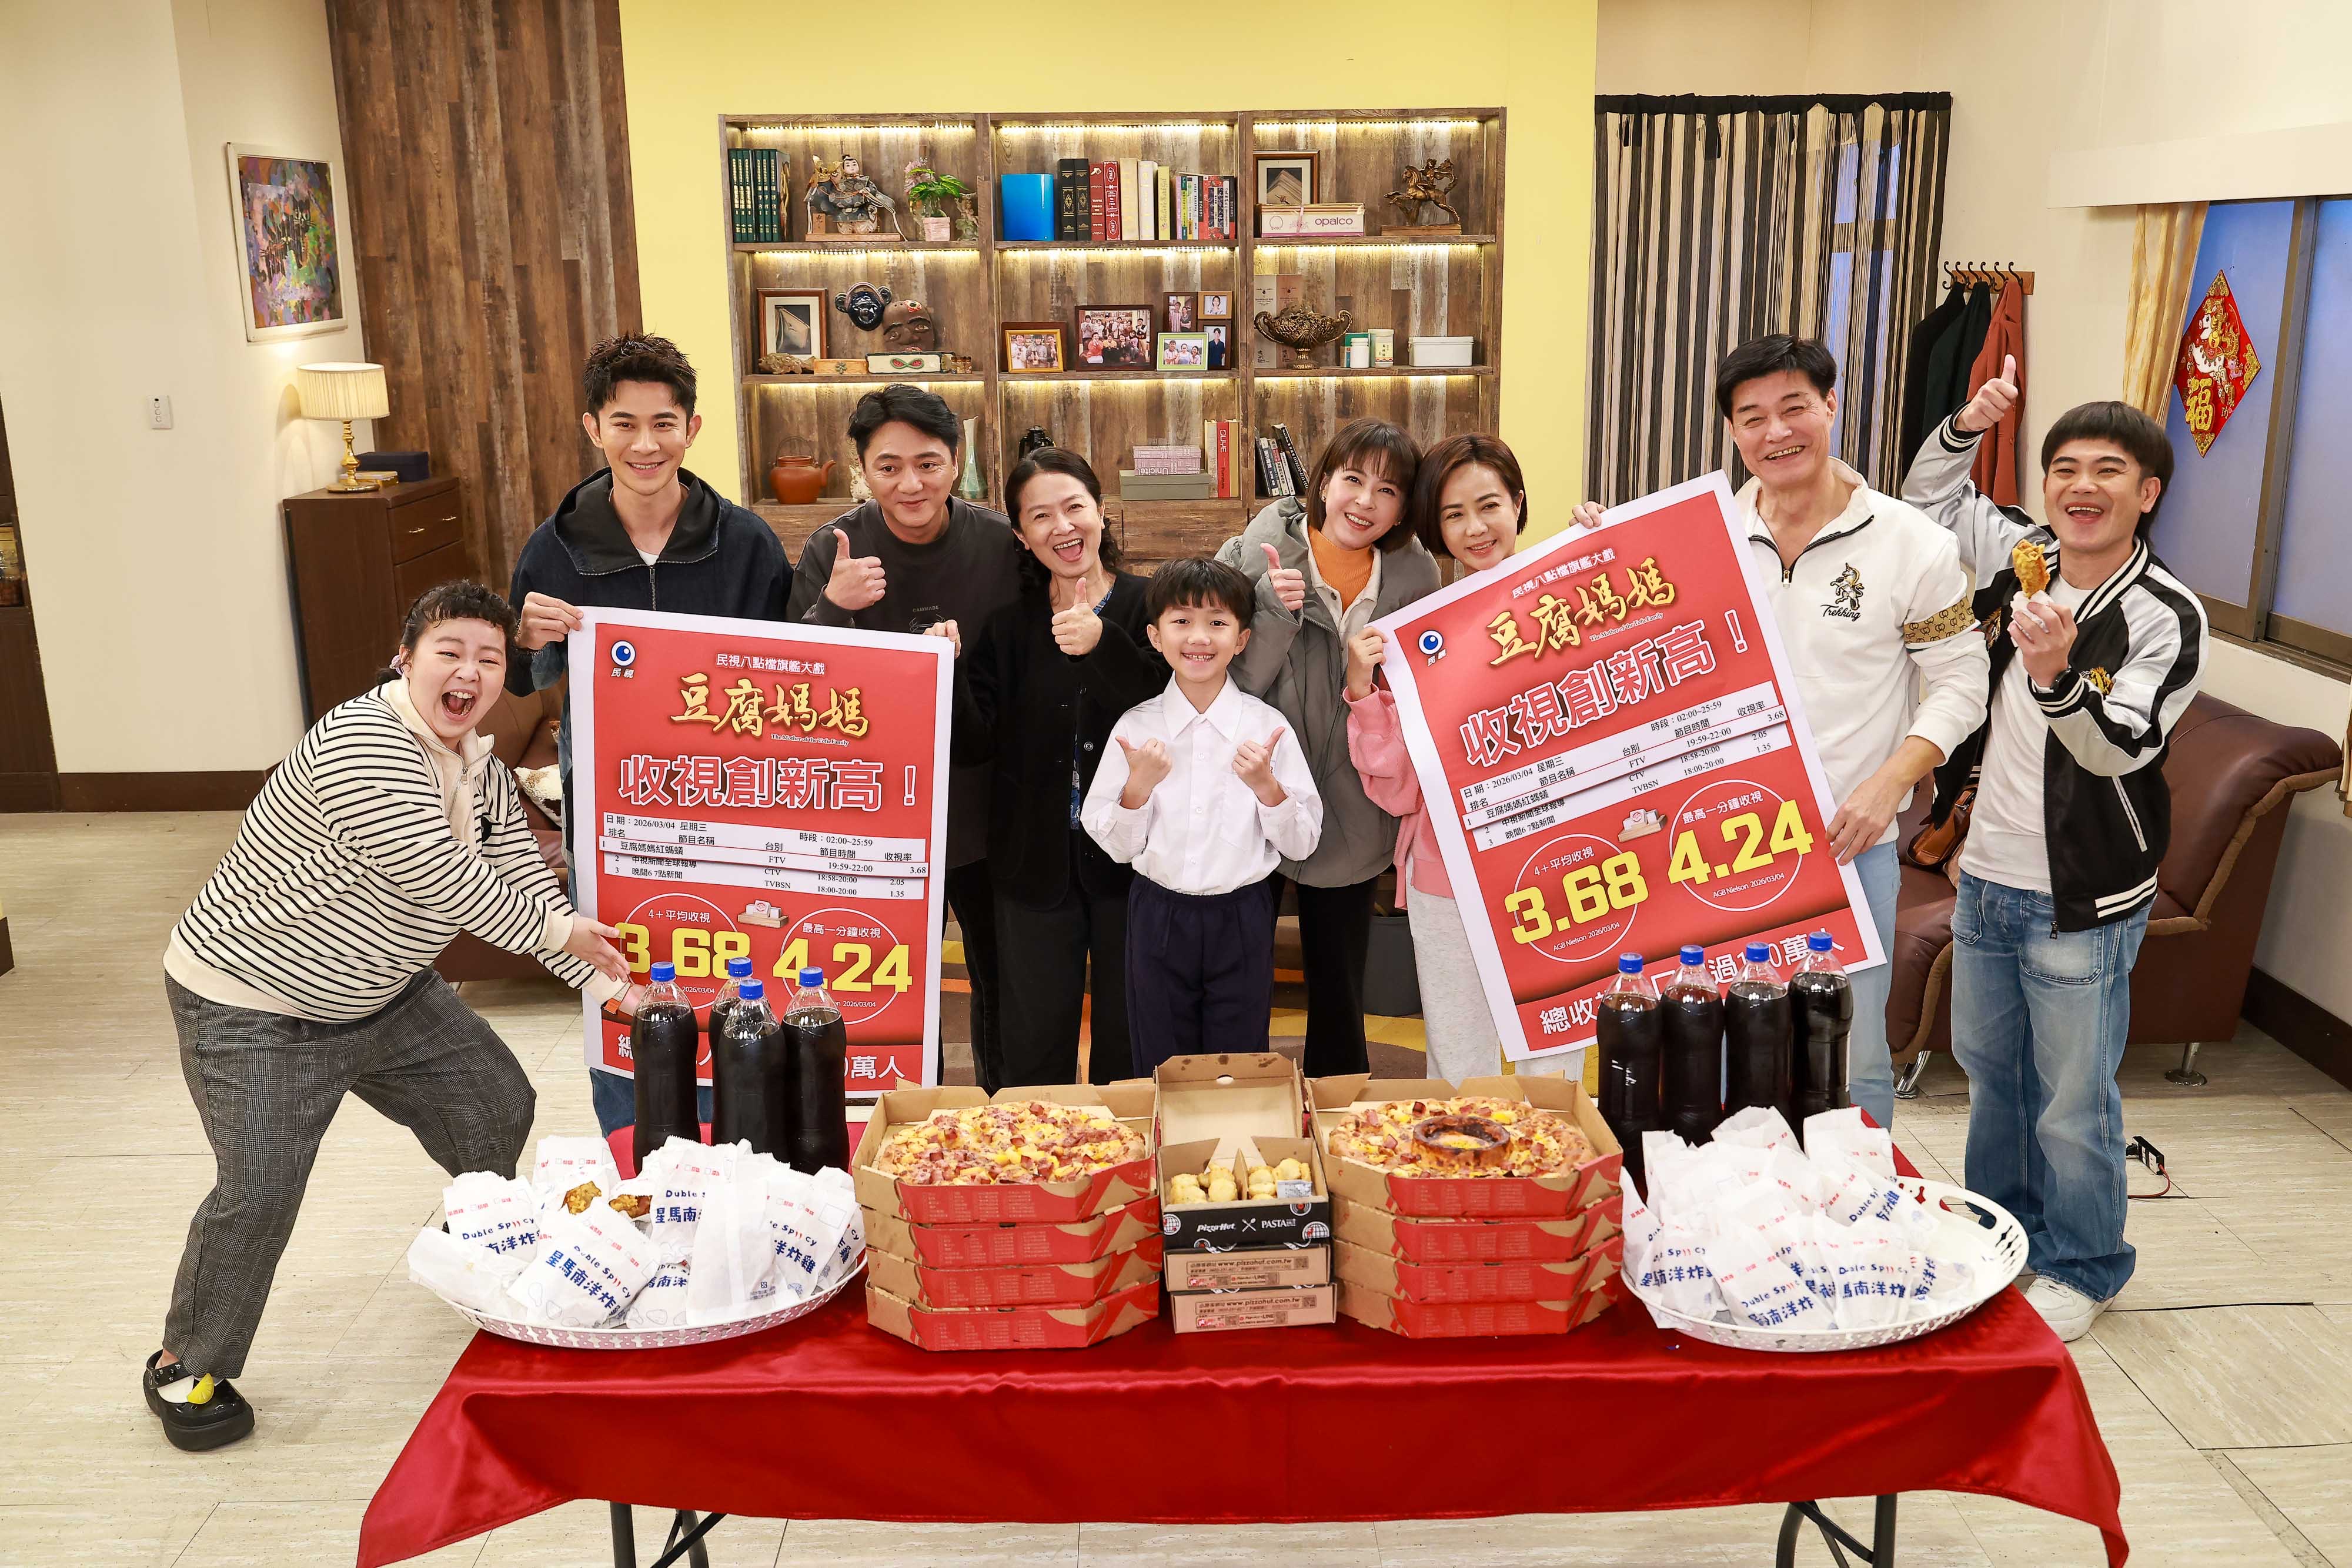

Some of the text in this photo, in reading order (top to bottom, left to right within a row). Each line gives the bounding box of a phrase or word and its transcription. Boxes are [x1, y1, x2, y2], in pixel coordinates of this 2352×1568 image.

[1315, 217, 1353, 226] opalco
[2186, 376, 2213, 432] 福
[1512, 548, 1616, 600] 民視八點檔旗艦大戲
[1488, 557, 1676, 667] 豆腐媽媽
[1820, 604, 1861, 621] Trekking
[1601, 628, 1619, 638] Mother
[1646, 612, 1663, 622] Family
[716, 653, 825, 676] 民視八點檔旗艦大戲
[1427, 648, 1446, 667] 民視
[610, 667, 634, 678] 民視
[670, 673, 869, 738] 豆腐媽媽
[1676, 701, 1722, 723] 02:00~25:59
[1738, 701, 1765, 716] 收視率
[1675, 718, 1710, 738] 節目時間
[1622, 743, 1639, 757] 台別
[1629, 770, 1646, 782] CTV
[1680, 744, 1720, 764] 18:58-20:00
[1752, 730, 1768, 741] 2.05
[1485, 790, 1549, 819] 豆腐媽媽紅螞蟻
[1629, 756, 1646, 768] FTV
[1686, 727, 1732, 748] 19:59-22:00
[1768, 710, 1785, 722] 3.68
[1492, 768, 1533, 788] 2026/03/04
[1536, 756, 1564, 773] 星期三
[1632, 779, 1659, 794] TVBSN
[1683, 757, 1725, 776] 18:00-20:00
[1756, 743, 1771, 754] 1.35
[1539, 767, 1575, 787] 節目名稱
[1470, 798, 1489, 811] 排名
[1682, 790, 1763, 825] 最高一分鐘收視
[609, 828, 625, 838] 排名
[634, 819, 675, 829] 2026/03/04
[680, 822, 707, 832] 星期三
[679, 835, 714, 845] 節目名稱
[766, 842, 783, 851] 台別
[826, 836, 873, 847] 02:00~25:59
[1667, 798, 1815, 886] 4.24
[620, 841, 683, 855] 豆腐媽媽紅螞蟻
[828, 862, 873, 872] 19:59-22:00
[820, 848, 856, 858] 節目時間
[884, 852, 912, 861] 收視率
[764, 880, 791, 889] TVBSN
[817, 886, 857, 895] 18:00-20:00
[817, 874, 857, 883] 18:58-20:00
[1713, 872, 1785, 898] AGB Nielson 2026/03/04
[1504, 850, 1649, 945] 3.68
[802, 922, 881, 939] 最高一分鐘收視
[1553, 922, 1620, 951] AGB Nielson 2026/03/04
[614, 922, 751, 979] 368
[682, 986, 715, 994] 2026/03/04
[1849, 1200, 1872, 1222] Duble
[462, 1228, 493, 1240] Duble
